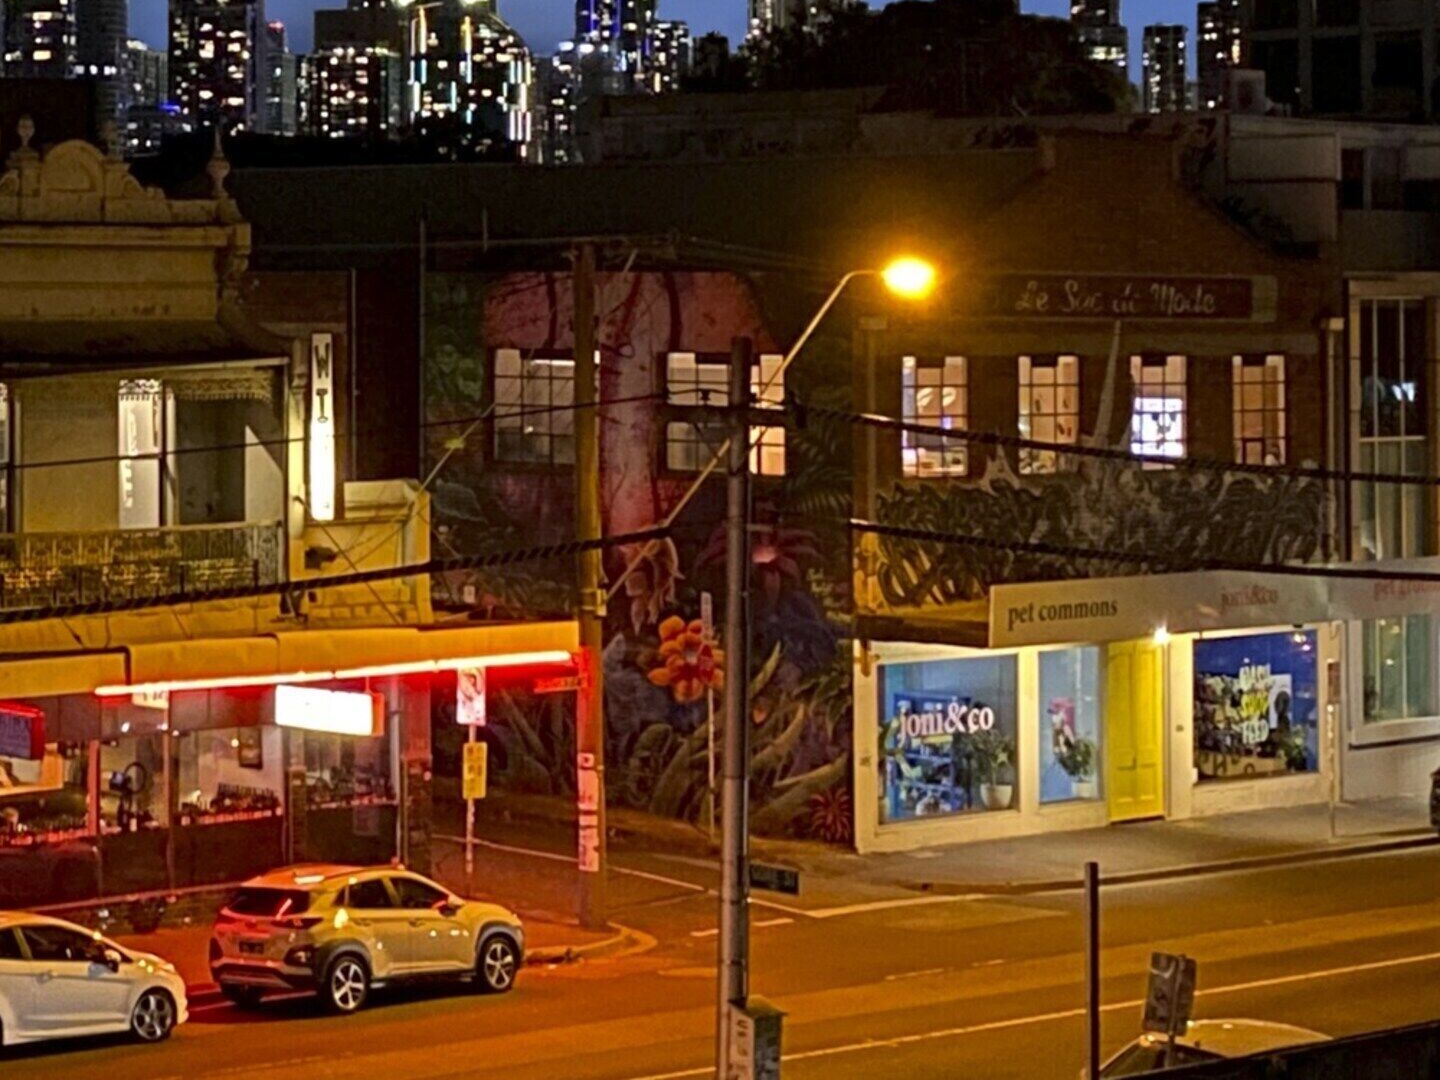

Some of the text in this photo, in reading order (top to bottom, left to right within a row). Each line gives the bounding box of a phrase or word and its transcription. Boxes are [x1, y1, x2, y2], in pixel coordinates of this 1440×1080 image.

[1008, 600, 1118, 632] pet commons
[896, 699, 995, 749] joni&co
